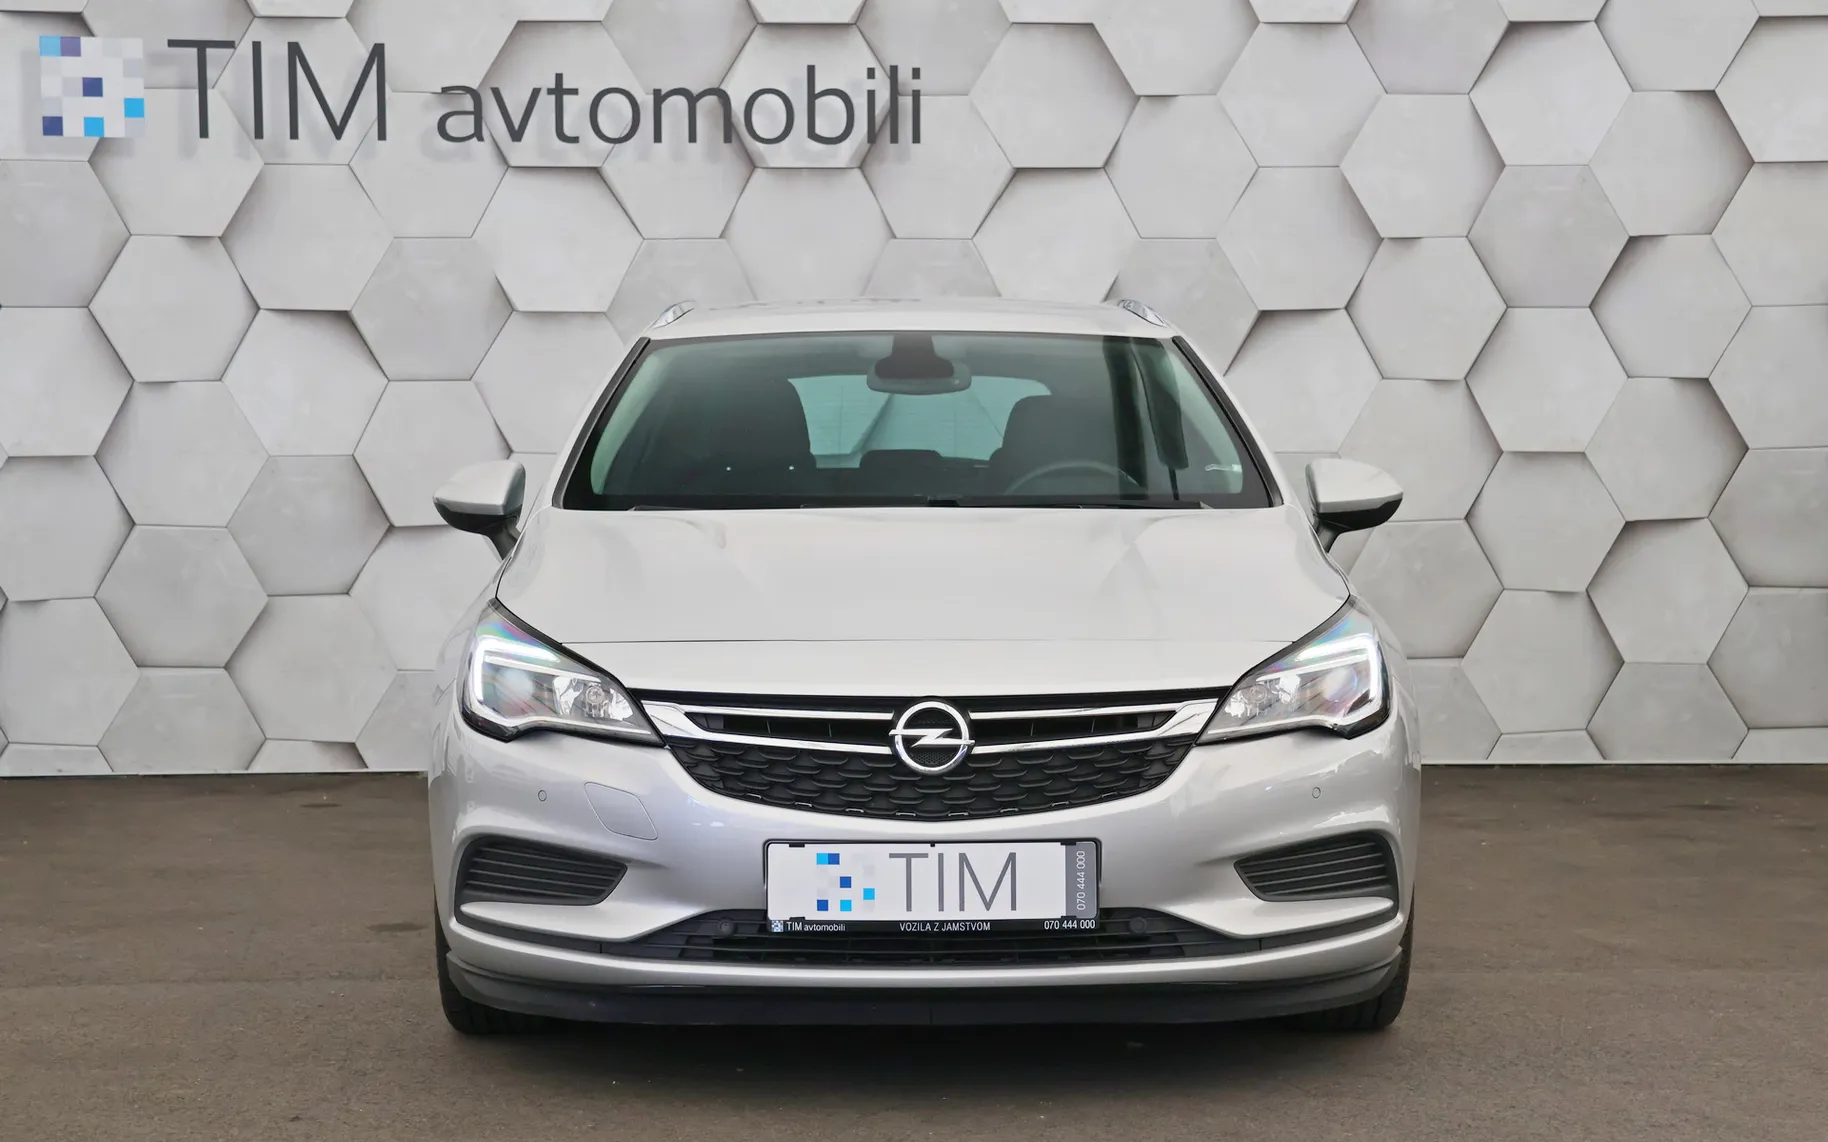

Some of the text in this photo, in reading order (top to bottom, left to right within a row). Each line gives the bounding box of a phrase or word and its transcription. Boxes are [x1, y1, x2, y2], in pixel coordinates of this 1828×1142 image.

[167, 39, 922, 146] TIM avtomobili
[888, 851, 1017, 913] TIM
[1076, 850, 1086, 911] 070 444 000
[786, 921, 846, 932] TIM avtomobili
[899, 921, 991, 932] VOZILA Z JAMSTVOM
[1044, 919, 1096, 930] 070 444 000
